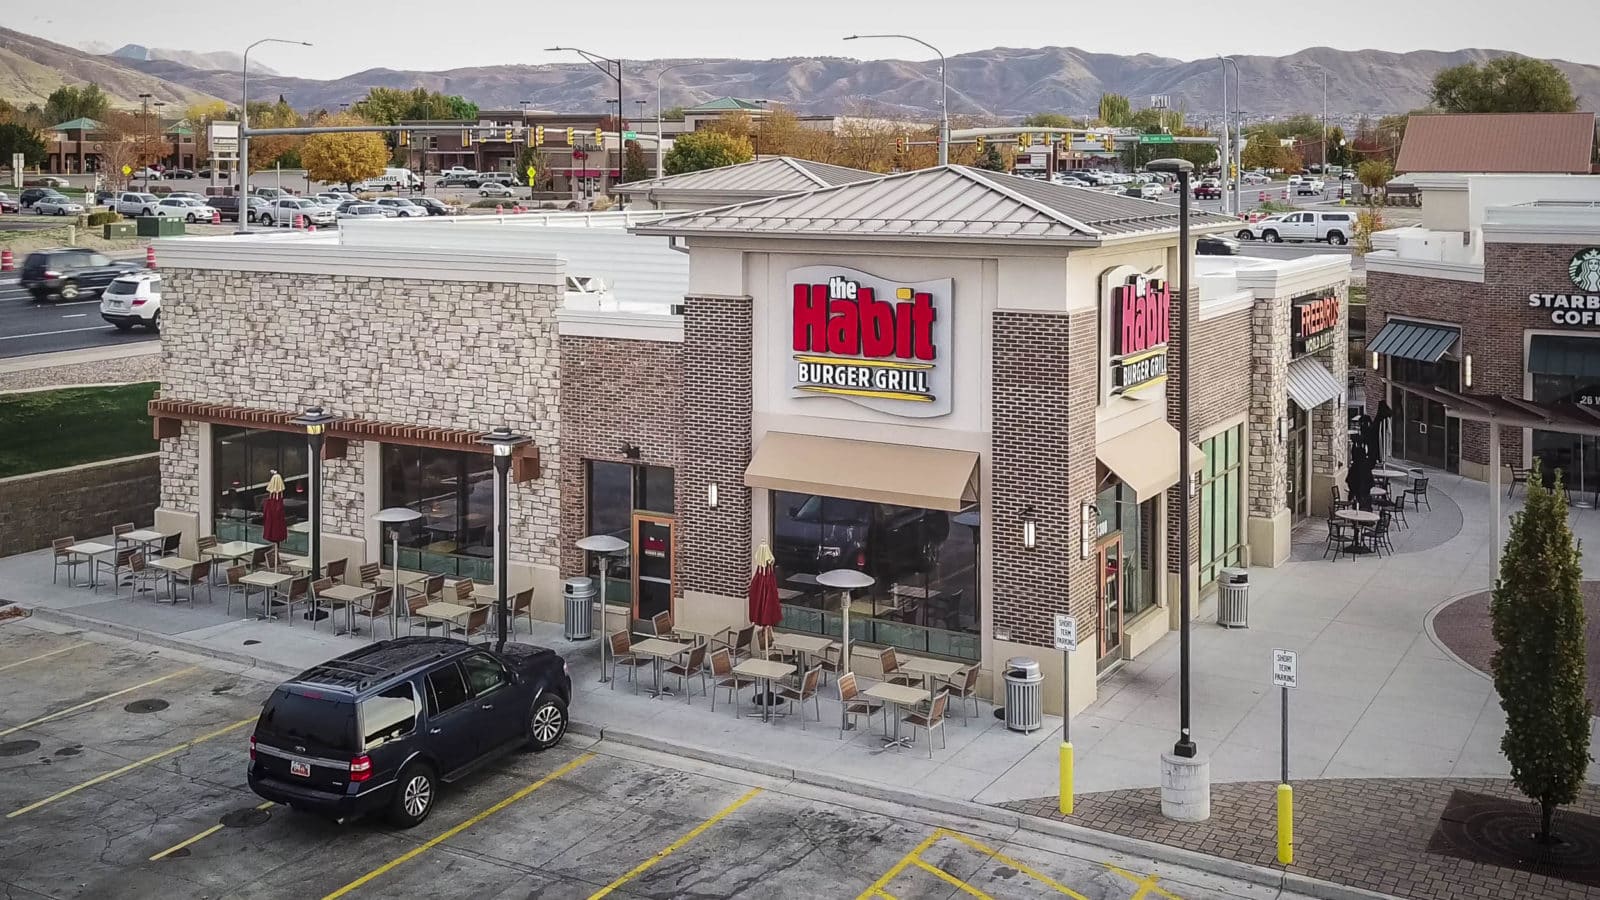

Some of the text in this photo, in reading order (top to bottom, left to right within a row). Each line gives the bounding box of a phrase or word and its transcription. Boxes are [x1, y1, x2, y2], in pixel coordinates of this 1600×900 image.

[829, 277, 857, 299] the
[793, 284, 937, 360] Habit
[1122, 280, 1170, 356] Habit
[1301, 296, 1339, 337] FREEBIRDS
[1123, 354, 1167, 386] BURGER GRILL
[800, 363, 927, 393] BURGER GRILL
[1059, 619, 1072, 627] SHORT
[1061, 628, 1071, 637] TERM
[1057, 637, 1075, 646] PARKING
[1277, 654, 1292, 662] SHORT
[1279, 664, 1291, 672] TERM
[1275, 673, 1295, 682] PARKING
